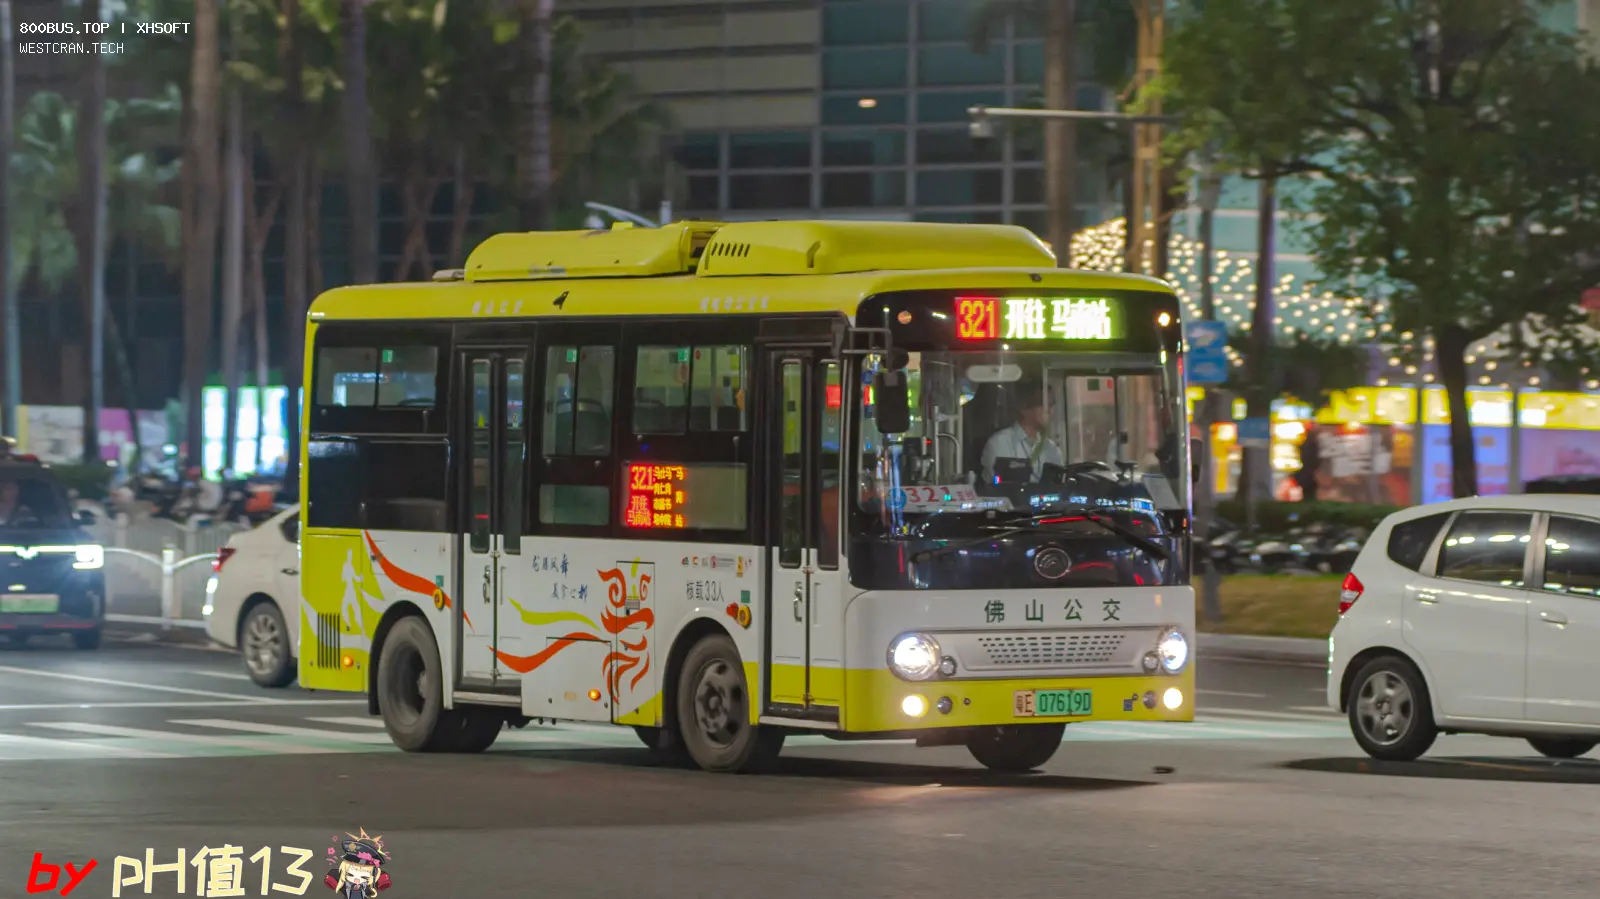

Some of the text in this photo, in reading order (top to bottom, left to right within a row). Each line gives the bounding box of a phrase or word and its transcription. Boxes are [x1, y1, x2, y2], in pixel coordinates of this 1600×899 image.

[958, 299, 996, 338] 321
[631, 466, 653, 490] 321
[983, 597, 1122, 624] 佛山公交
